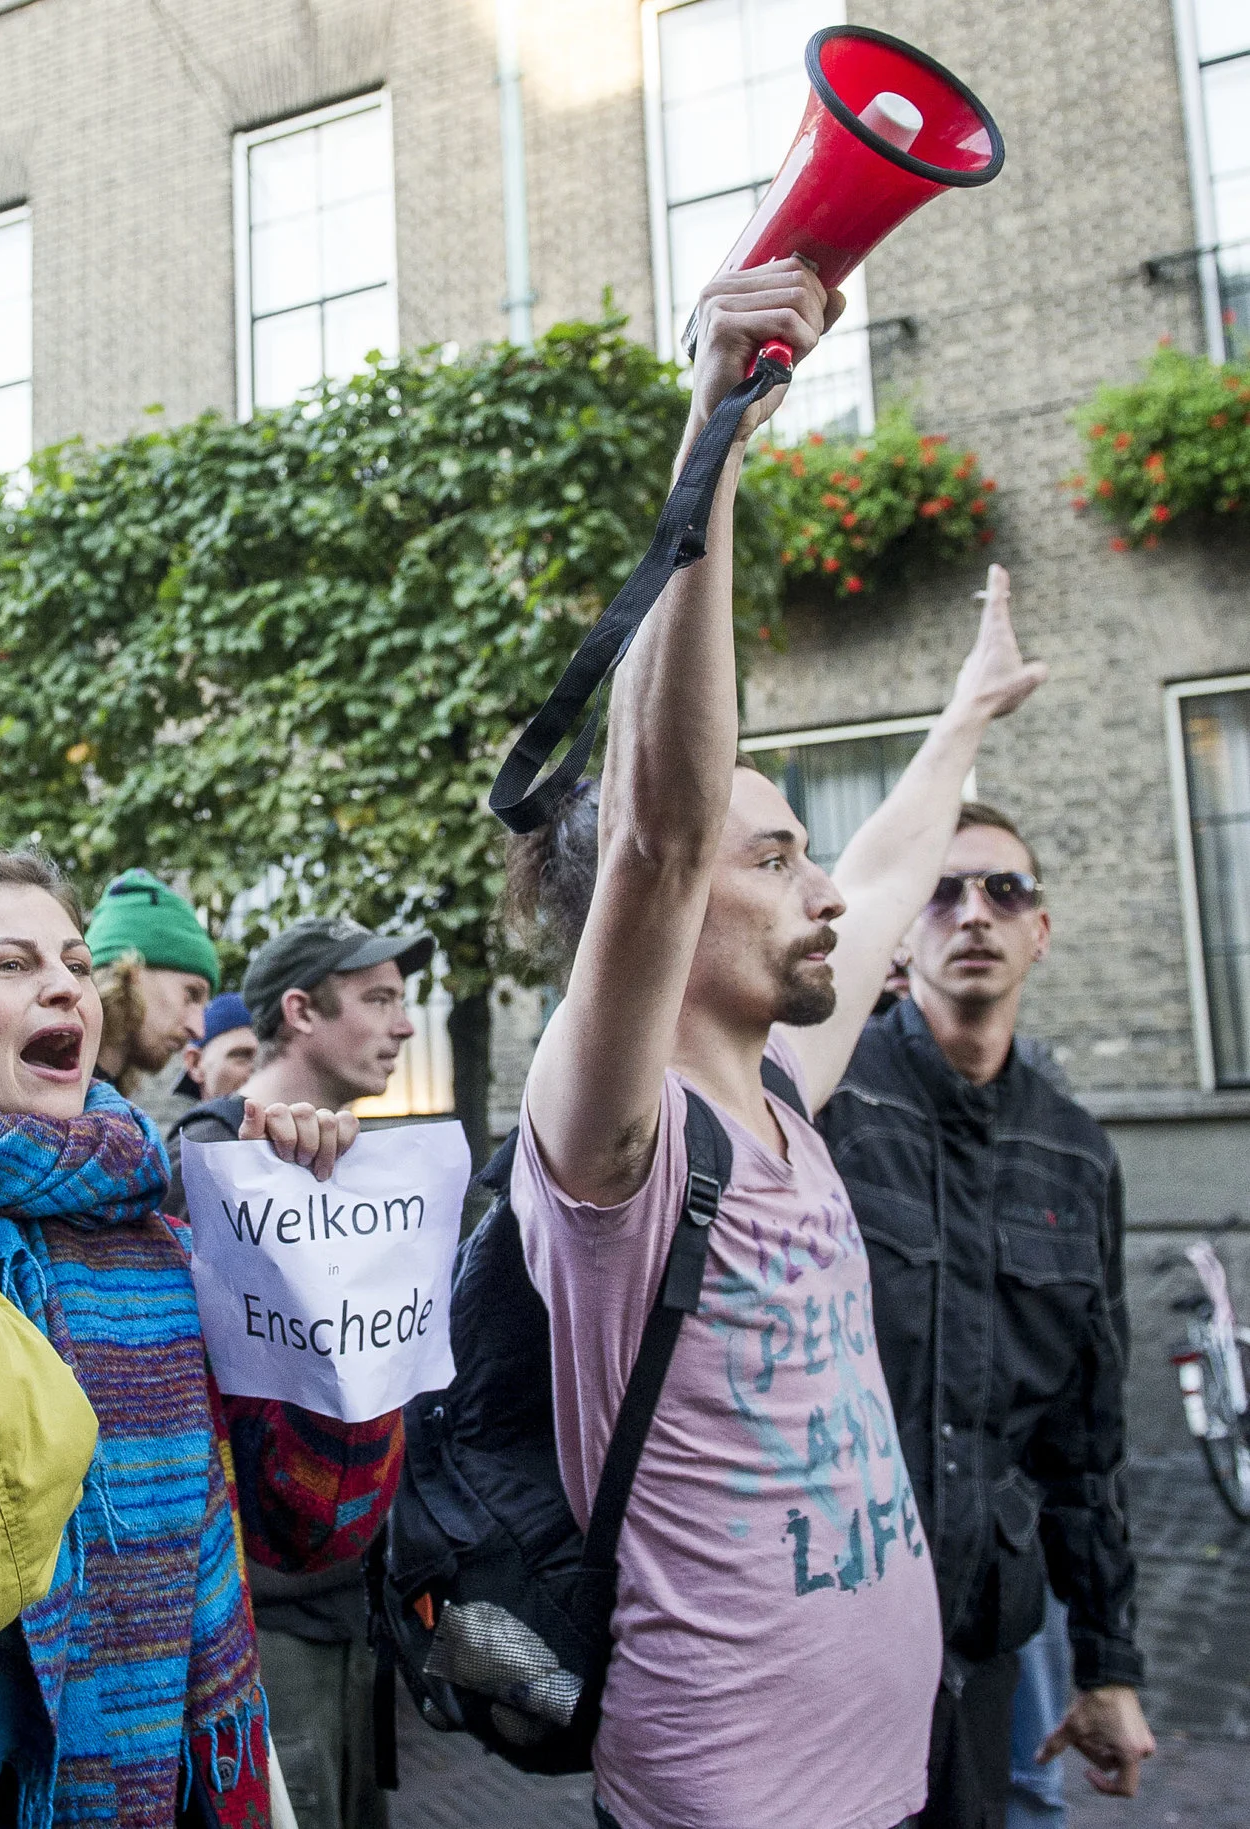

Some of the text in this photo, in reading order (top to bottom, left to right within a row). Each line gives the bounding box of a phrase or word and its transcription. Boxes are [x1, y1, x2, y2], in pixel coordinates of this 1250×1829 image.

[221, 1193, 424, 1246] Welkom
[327, 1262, 340, 1276] in
[243, 1287, 433, 1357] Enschede
[784, 1487, 923, 1597] LIFE
